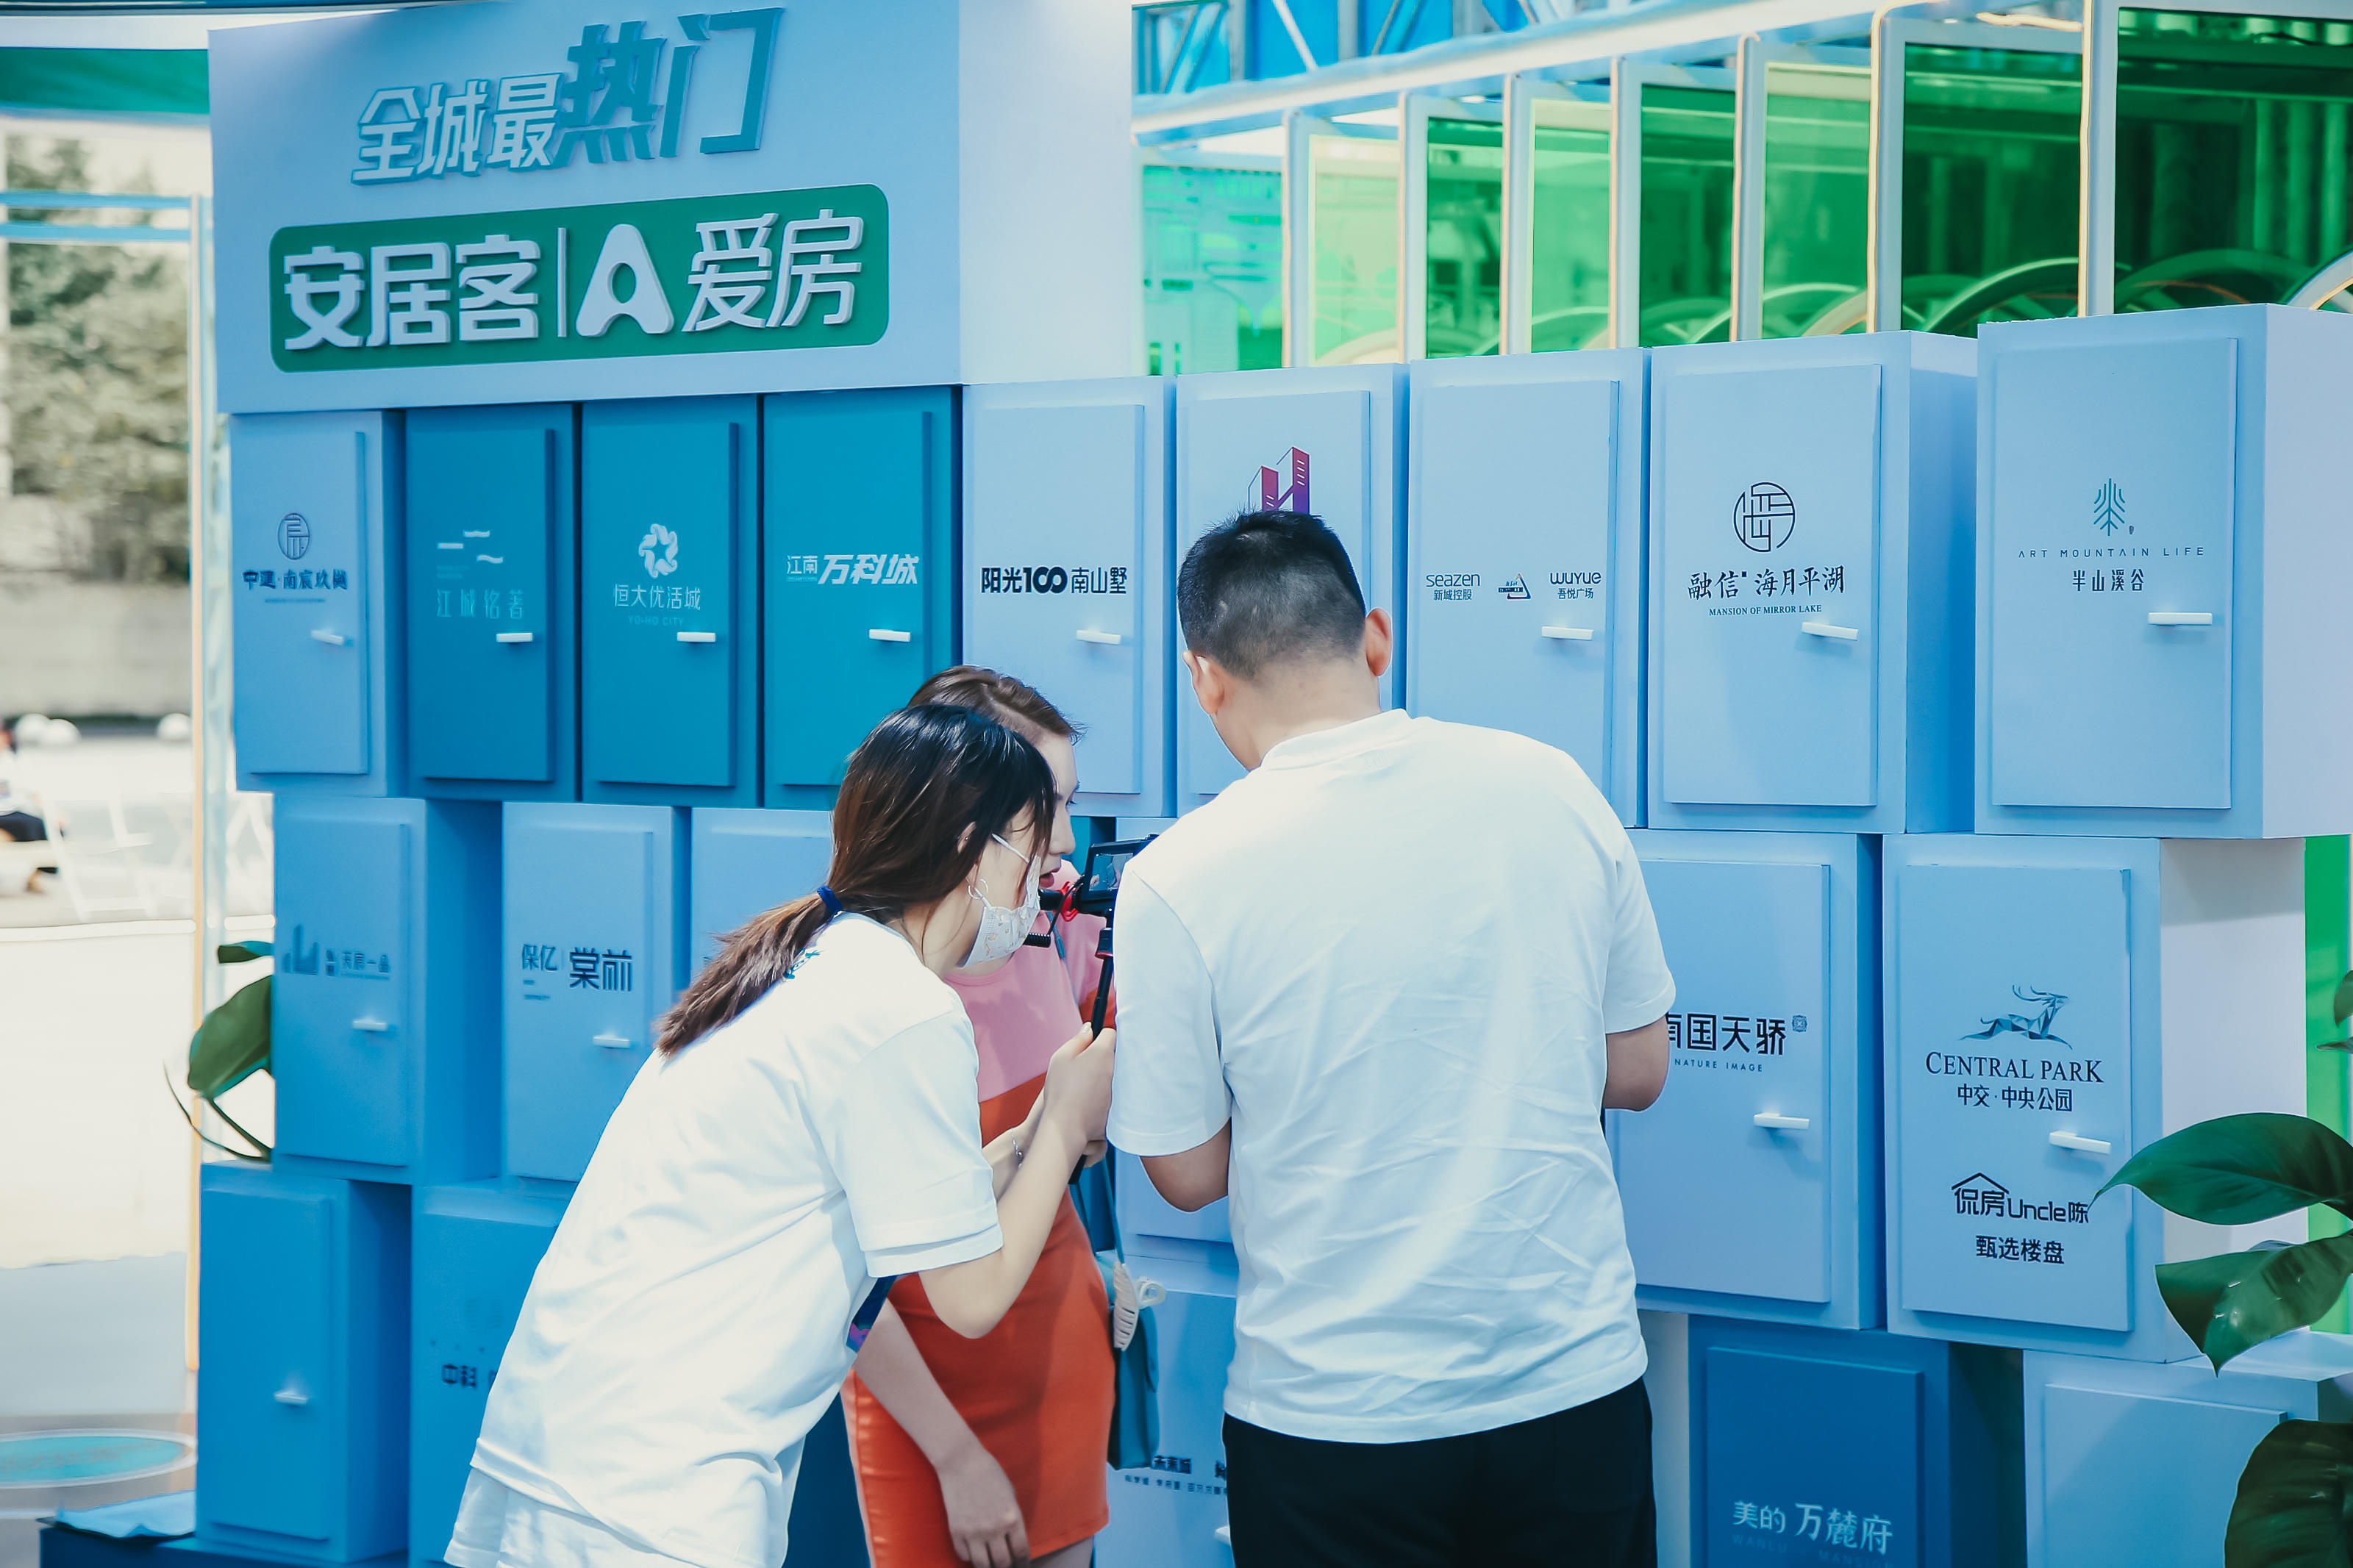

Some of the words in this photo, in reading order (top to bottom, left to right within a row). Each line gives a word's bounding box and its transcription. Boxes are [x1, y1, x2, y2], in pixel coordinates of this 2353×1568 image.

[351, 6, 786, 185] 全城最热门
[283, 235, 542, 351] 安居客
[682, 209, 865, 333] 爱房
[2018, 550, 2048, 558] ART
[2060, 548, 2149, 558] MOUNTAIN
[2164, 547, 2204, 556] LIFE
[1426, 573, 1480, 587] seazen
[1688, 570, 1739, 600] 融信
[1754, 565, 1844, 597] 海月平湖
[2072, 568, 2144, 592] 半山溪谷
[613, 584, 701, 610] 恒大优活城
[1434, 589, 1472, 601] 新城控股
[1557, 588, 1594, 599] 吾悦广场
[1709, 607, 1747, 617] MANSION
[1750, 606, 1761, 615] OF
[1763, 605, 1796, 615] MIRROR
[1799, 604, 1822, 613] LAKE
[522, 943, 557, 971] 保亿
[1674, 1058, 1718, 1069] NATURE
[1726, 1062, 1763, 1072] IMAGE
[1926, 1051, 2035, 1080] CENTRAL
[2041, 1059, 2104, 1083] PARK
[1976, 1235, 2065, 1264] 甄选楼盘
[1732, 1501, 1786, 1533] 美的
